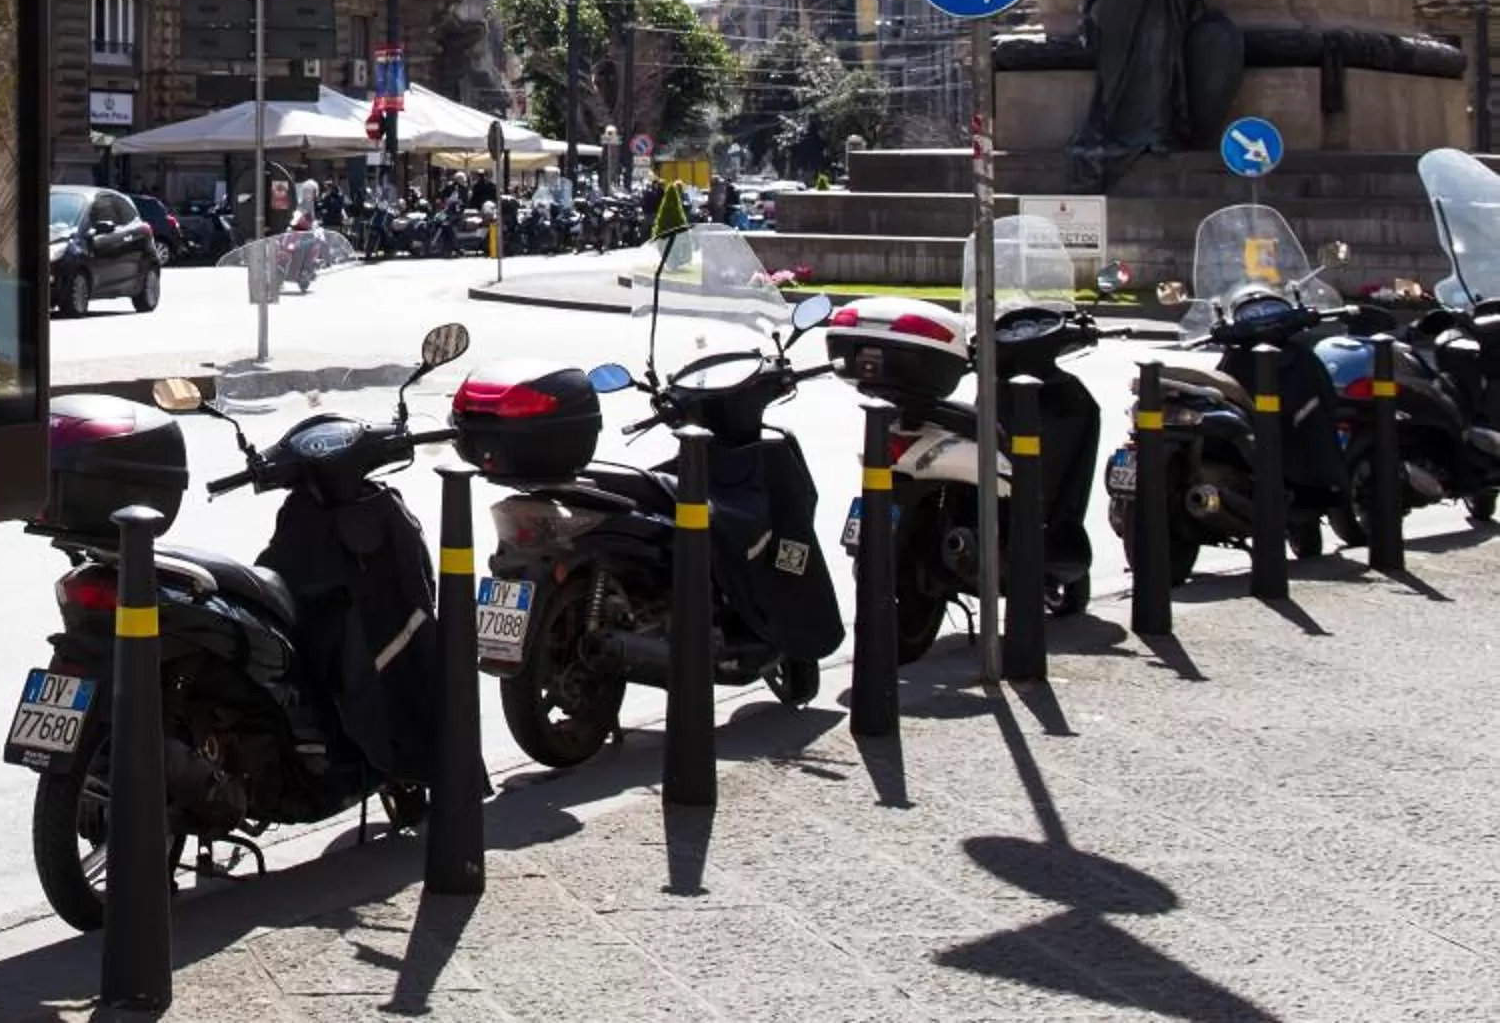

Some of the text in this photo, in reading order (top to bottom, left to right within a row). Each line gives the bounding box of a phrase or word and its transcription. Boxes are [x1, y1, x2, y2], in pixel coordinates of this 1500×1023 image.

[491, 581, 512, 606] DV
[479, 610, 524, 638] 17088
[40, 676, 70, 703] DV
[14, 709, 80, 746] 77680
